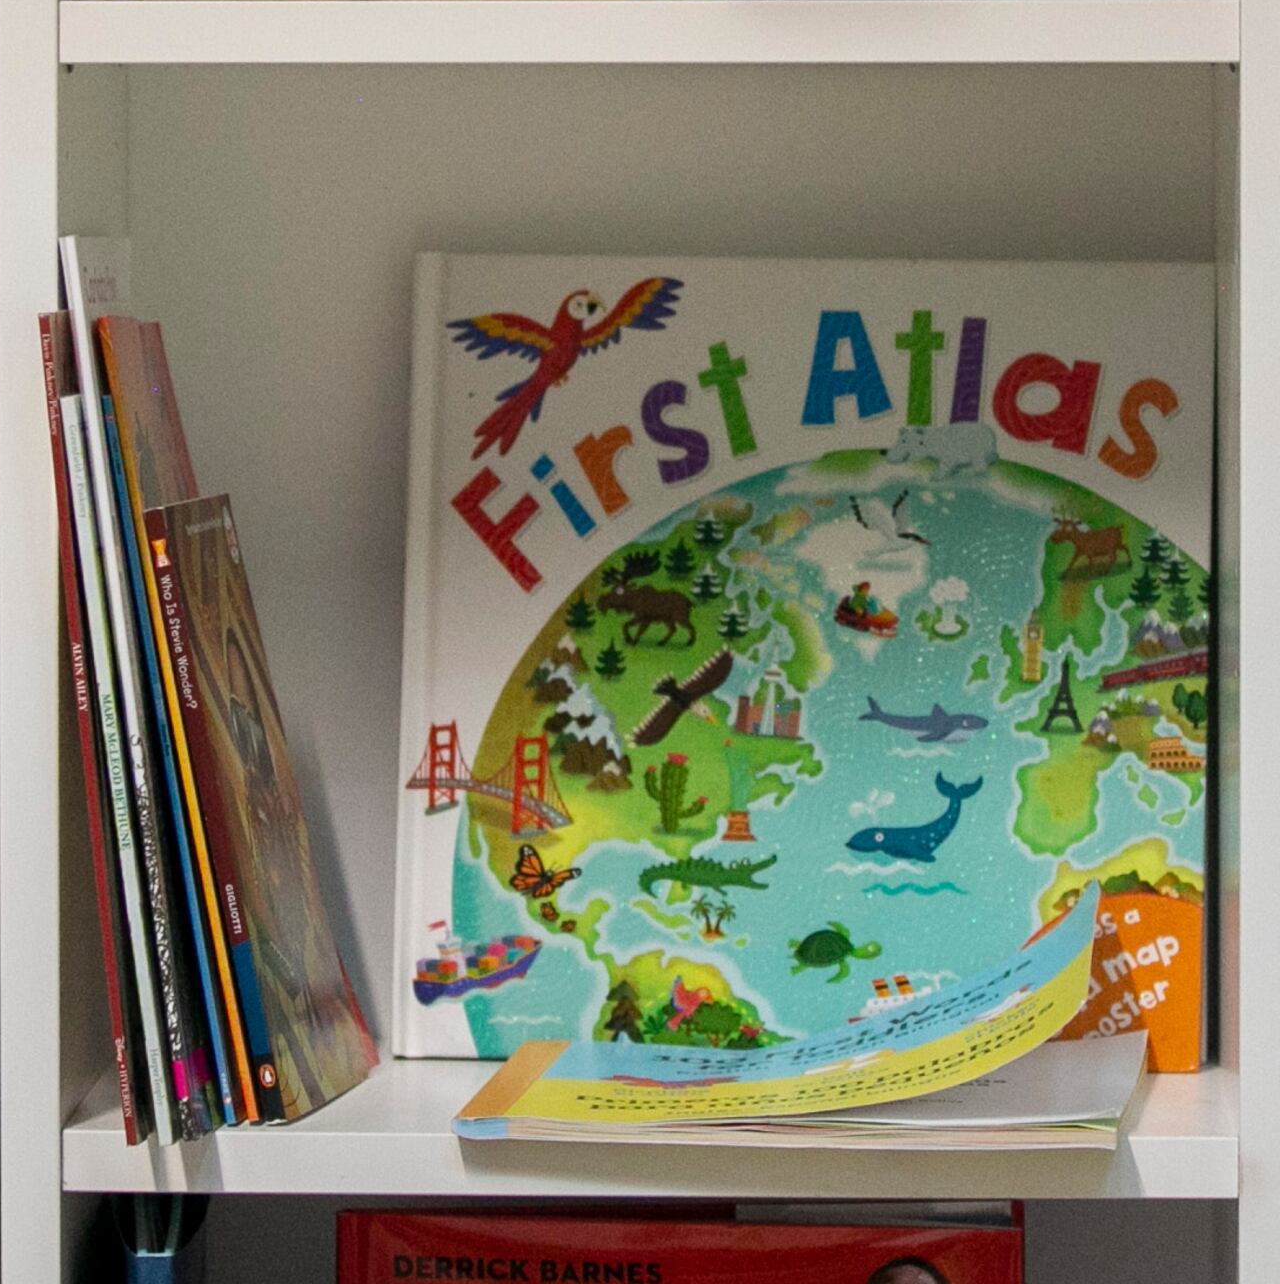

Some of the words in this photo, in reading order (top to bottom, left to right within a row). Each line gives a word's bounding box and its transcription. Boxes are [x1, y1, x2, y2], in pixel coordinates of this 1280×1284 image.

[451, 340, 757, 594] First
[801, 310, 1180, 479] Atlas
[73, 482, 88, 518] Pinkney
[159, 574, 174, 600] Who
[165, 602, 177, 616] Is
[168, 617, 185, 653] Stevie
[70, 642, 84, 676] ALVIN
[74, 677, 87, 712] AILEY
[176, 655, 197, 709] Wonder?
[100, 693, 115, 729] MARY
[105, 732, 124, 785] McLEOD
[111, 788, 132, 851] BETHUNE
[223, 883, 243, 934] GIGLIOTTI
[1124, 908, 1141, 925] a
[1103, 935, 1180, 983] map
[118, 1070, 132, 1118] HYPERION
[391, 1254, 530, 1283] DERRICK
[538, 1258, 663, 1284] BARNES
